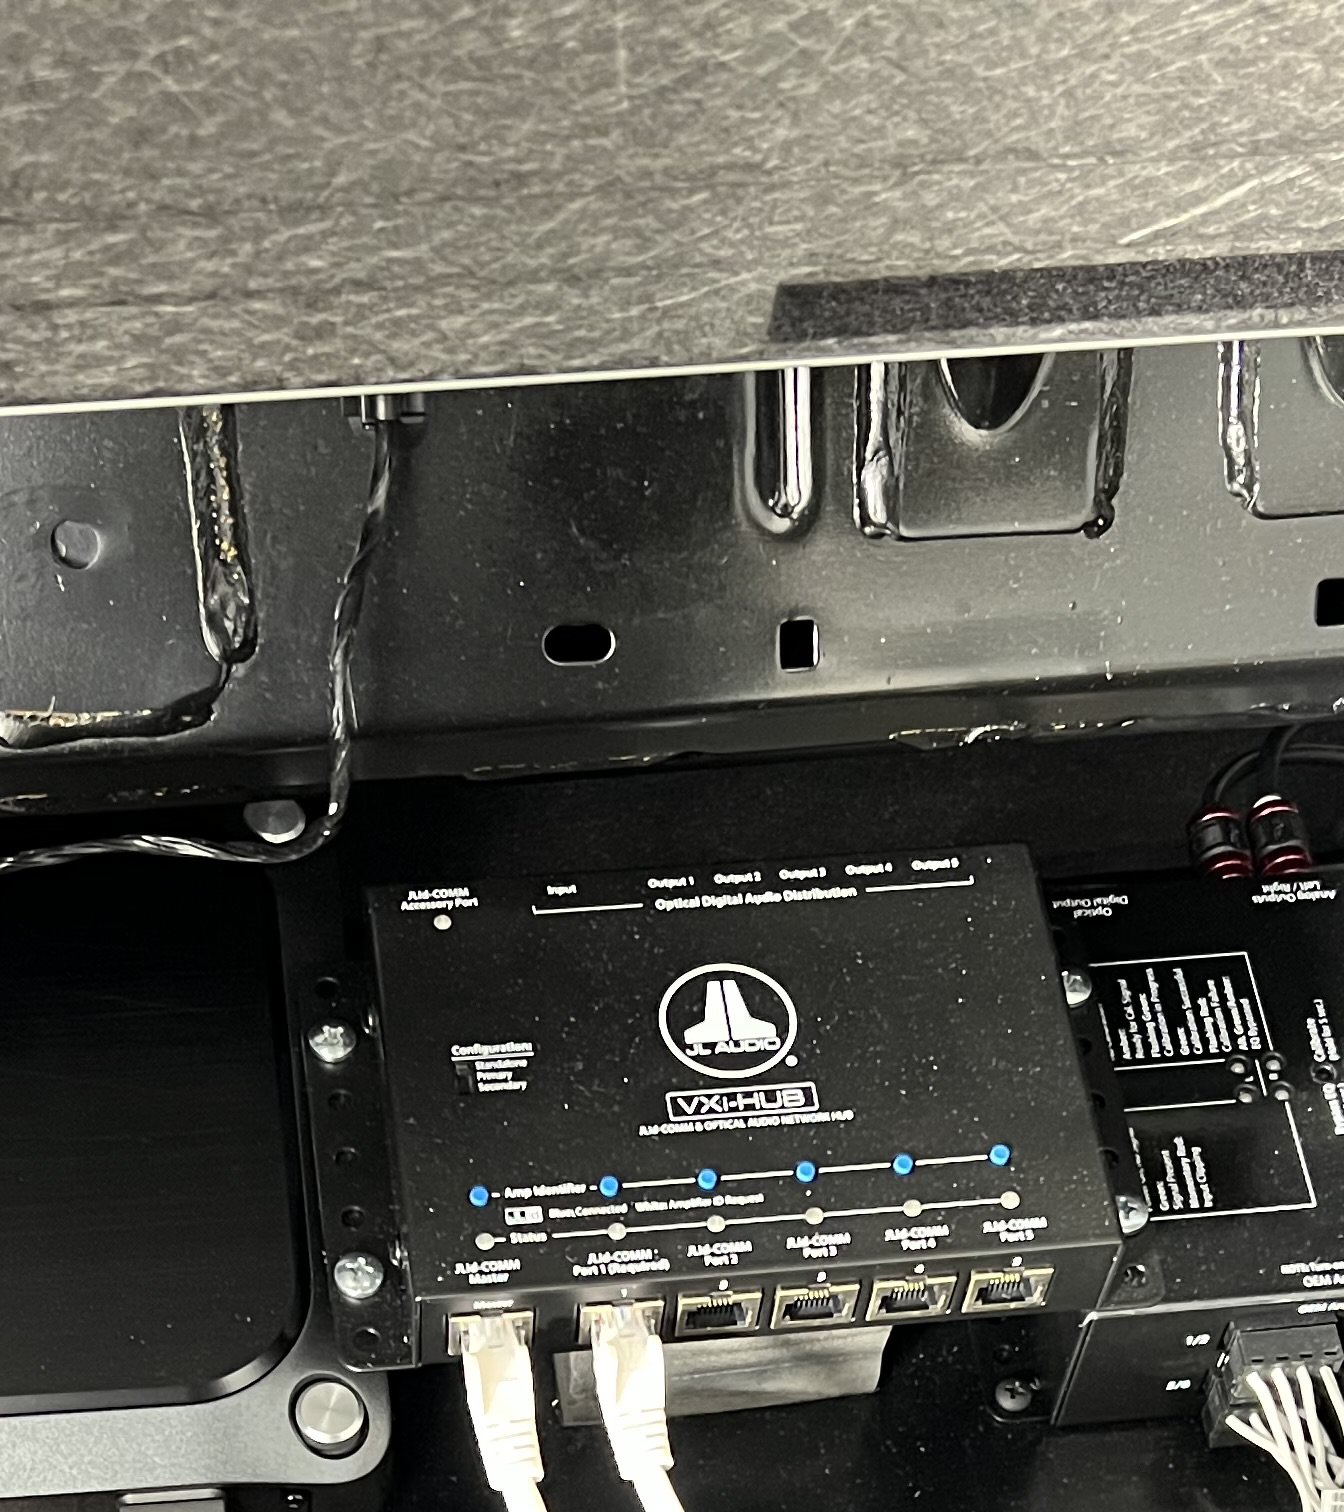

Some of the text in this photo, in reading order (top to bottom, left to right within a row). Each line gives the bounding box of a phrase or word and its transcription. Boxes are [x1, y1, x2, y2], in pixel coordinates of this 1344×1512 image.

[844, 864, 884, 876] Output
[910, 858, 950, 871] Output
[713, 873, 752, 884] Output
[779, 868, 818, 880] Output
[647, 877, 687, 889] Output
[546, 884, 577, 896] Input
[401, 897, 479, 911] Accessory Port
[654, 886, 857, 911] Optical Digital Audio Distribution
[685, 1037, 782, 1057] JL AUDIO
[677, 1089, 806, 1115] VXi-HUB
[704, 1119, 746, 1131] OPTICAL
[747, 1116, 780, 1128] AUDIO
[781, 1112, 830, 1126] NETWORK
[831, 1110, 855, 1121] HUB
[504, 1183, 587, 1200] Amp Identifier
[509, 1232, 547, 1245] Status
[999, 1230, 1023, 1243] Port
[901, 1237, 936, 1250] Port 4
[802, 1246, 825, 1259] Port
[704, 1253, 738, 1266] Port 2
[572, 1264, 598, 1277] Port
[607, 1259, 670, 1275] (Required)
[468, 1273, 509, 1285] Master
[1302, 1273, 1331, 1288] OEM
